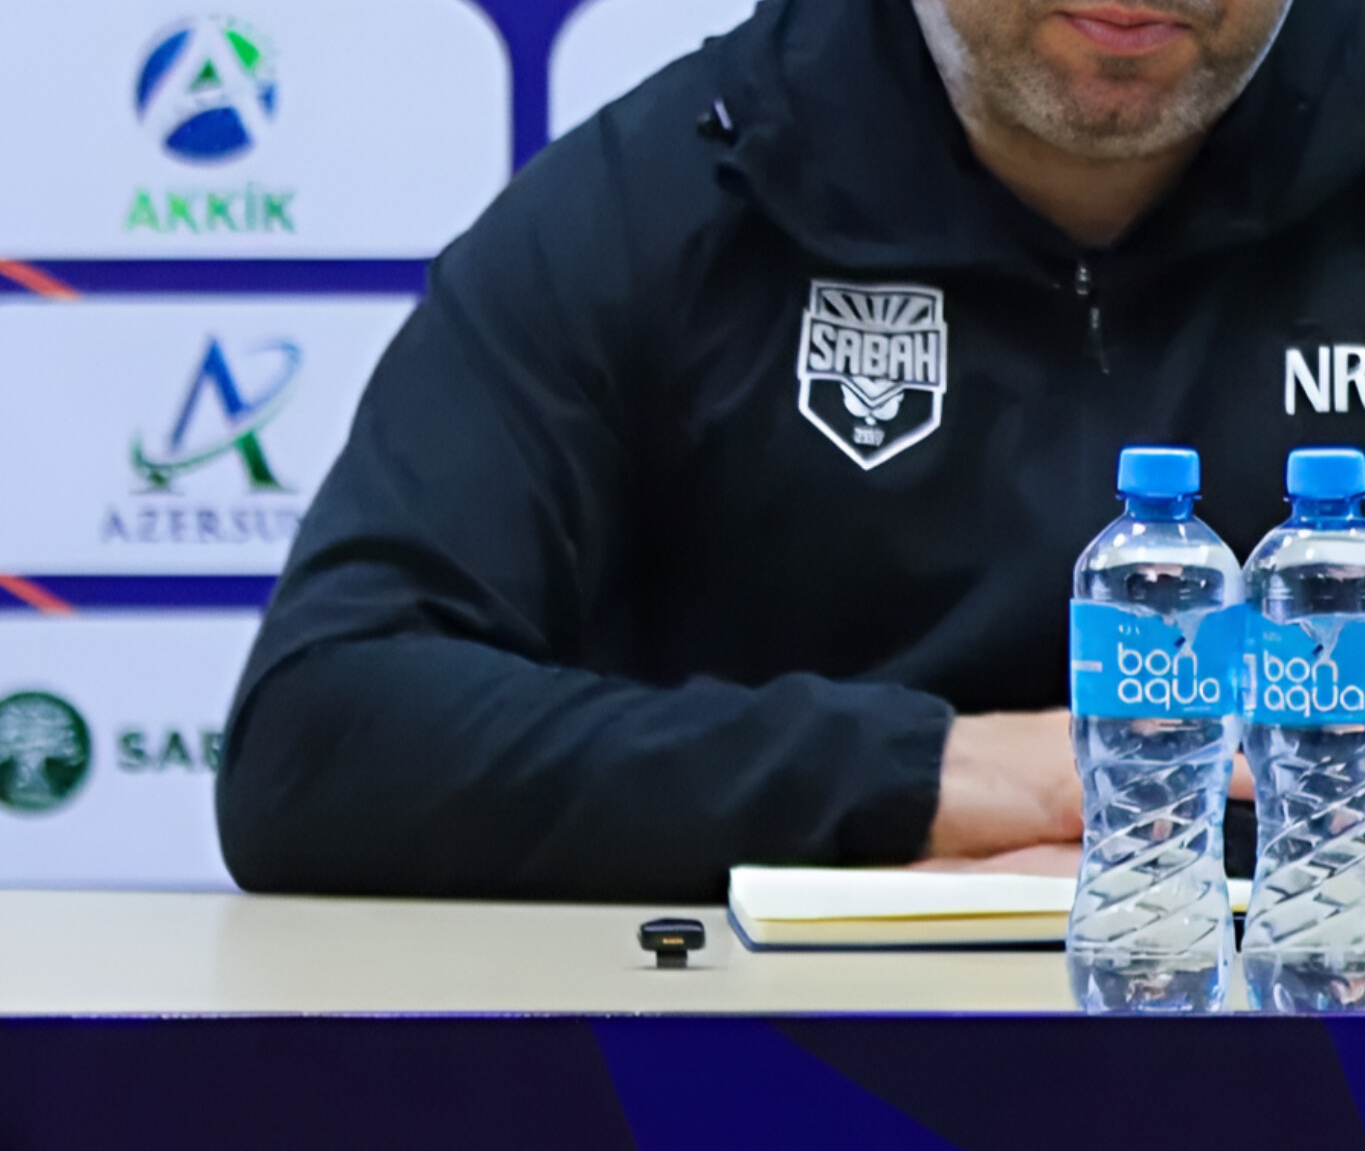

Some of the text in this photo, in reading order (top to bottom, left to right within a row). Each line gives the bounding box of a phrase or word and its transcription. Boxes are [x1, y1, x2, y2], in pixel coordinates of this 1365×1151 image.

[126, 182, 295, 233] AKKİK
[809, 322, 937, 384] SABAH
[102, 507, 298, 543] AZERSU
[1118, 642, 1198, 676] bon
[1263, 649, 1339, 683] bon
[1117, 677, 1221, 712] aqua
[1263, 684, 1365, 718] aqua
[117, 729, 222, 773] SAB
